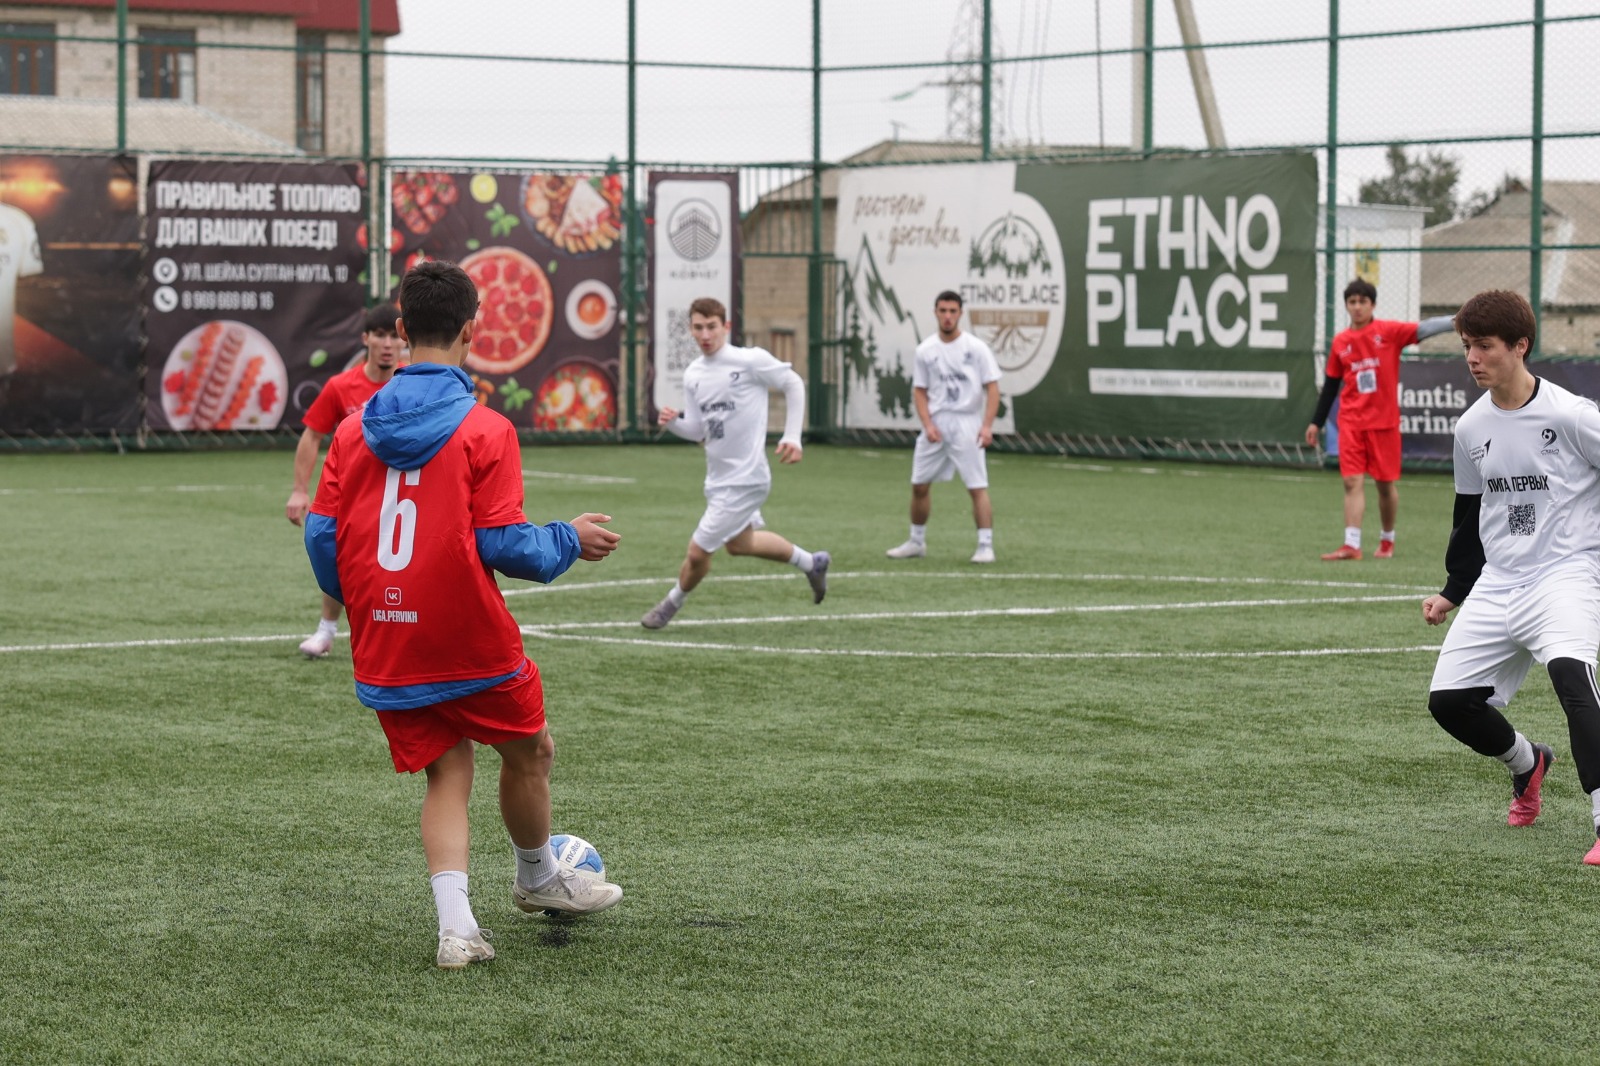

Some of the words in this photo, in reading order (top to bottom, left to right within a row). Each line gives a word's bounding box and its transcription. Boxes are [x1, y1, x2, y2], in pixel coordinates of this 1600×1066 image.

[156, 181, 277, 211] ПРАВИЛЬНОЕ
[279, 183, 361, 213] ТОПЛИВО
[156, 217, 199, 248] ДЛЯ
[200, 218, 268, 247] ВАШИХ
[271, 219, 338, 250] ПОБЕД!
[1086, 194, 1281, 271] ETHNO
[960, 284, 1006, 303] ETHNO
[1009, 284, 1060, 304] PLACE
[1086, 273, 1288, 349] PLACE
[1487, 477, 1511, 493] ЛИГА
[1511, 475, 1550, 492] ПЕРВЫХ
[377, 467, 420, 571] 6
[372, 609, 418, 623] LIGA.PERVIKH
